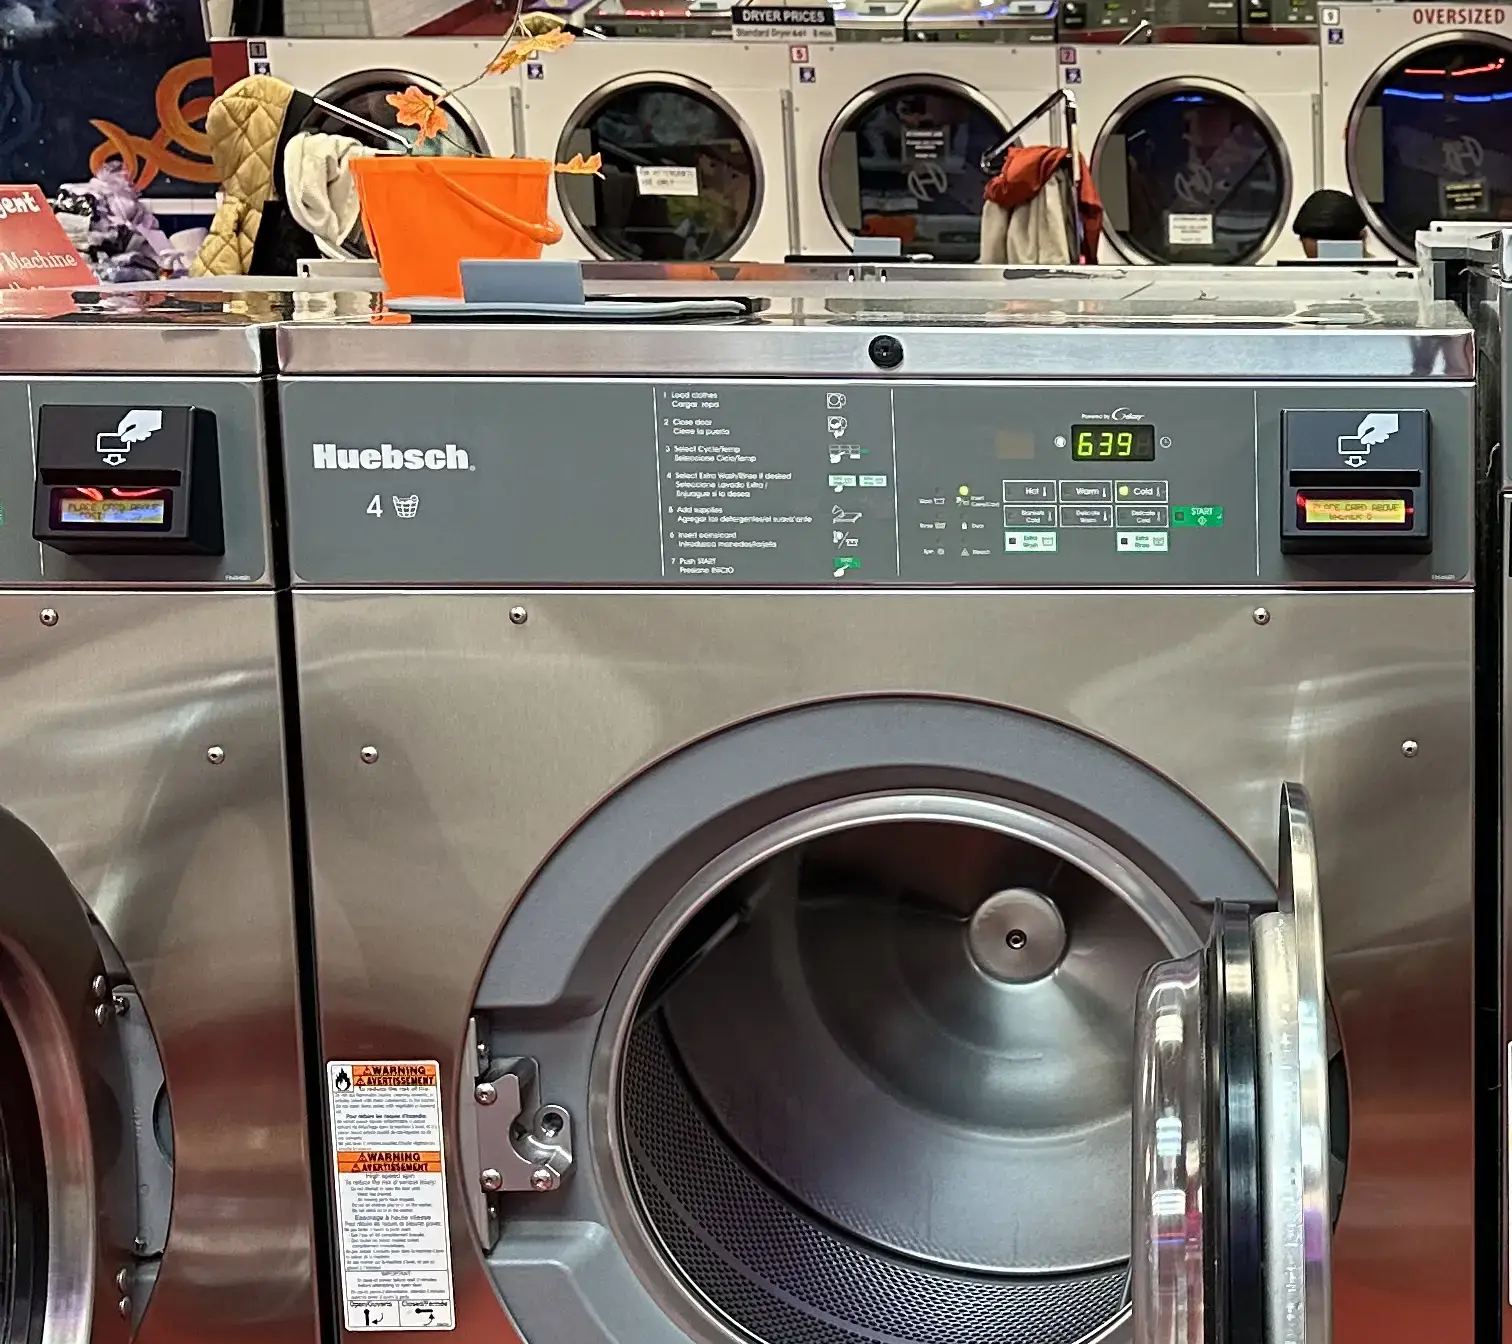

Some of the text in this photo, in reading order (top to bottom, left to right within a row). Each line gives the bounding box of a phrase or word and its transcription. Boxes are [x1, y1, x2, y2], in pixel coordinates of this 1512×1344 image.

[742, 10, 825, 23] DRYER PRICES
[1413, 9, 1505, 25] OVERSIZED
[4, 250, 77, 270] Machine
[1078, 432, 1132, 456] 639
[313, 444, 469, 470] Huebsch
[1025, 487, 1039, 495] Hot
[1133, 488, 1153, 496] Cold
[366, 495, 383, 517] 4
[372, 1066, 426, 1075] WARNING
[368, 1153, 420, 1161] WARNING
